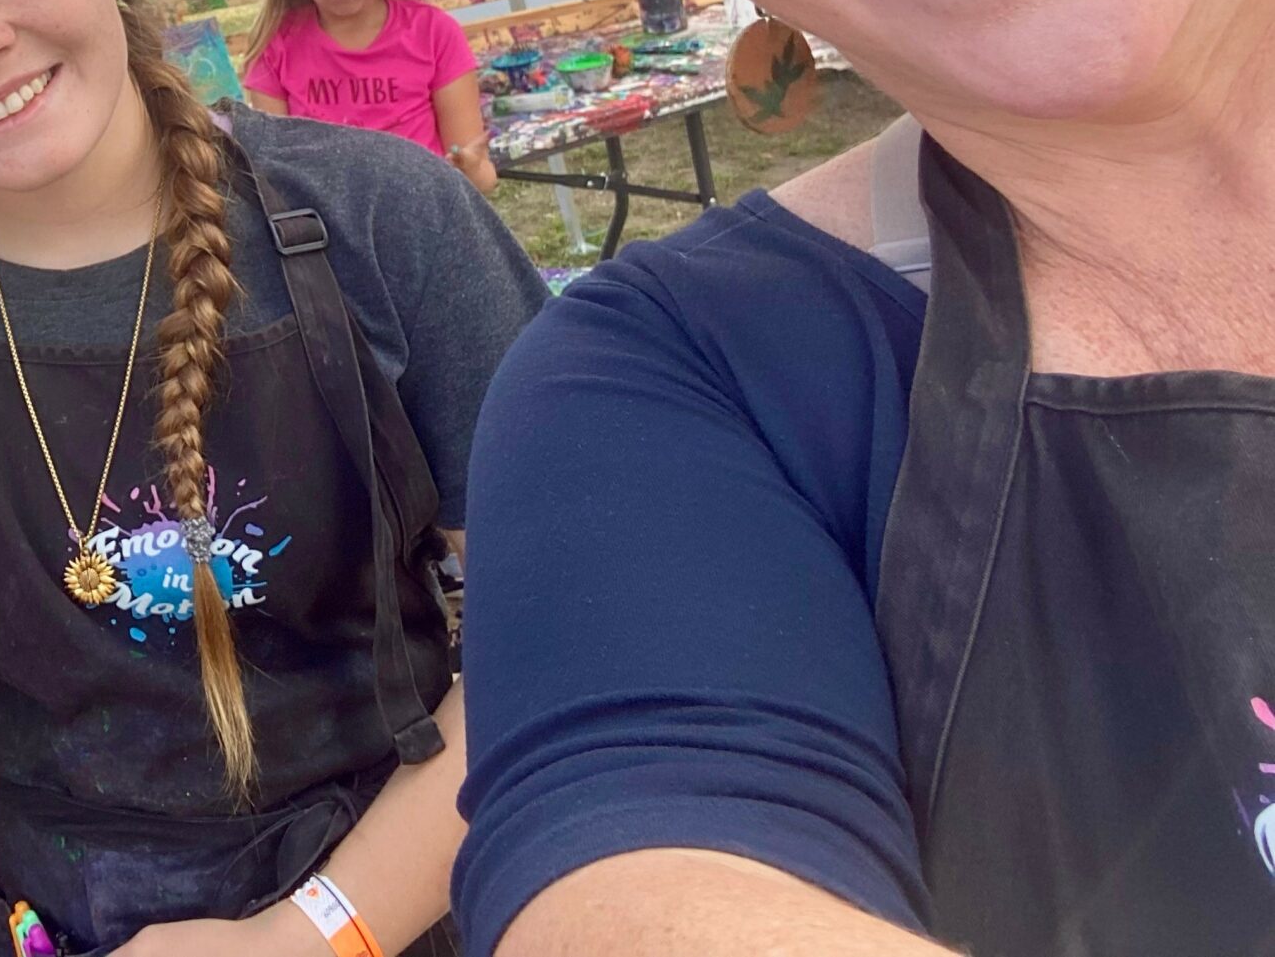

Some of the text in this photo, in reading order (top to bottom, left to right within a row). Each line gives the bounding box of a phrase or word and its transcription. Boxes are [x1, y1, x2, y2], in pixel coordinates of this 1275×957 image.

[308, 77, 400, 105] MY VIBE
[86, 526, 264, 574] Emoon
[162, 567, 194, 589] in
[104, 581, 267, 617] Motn
